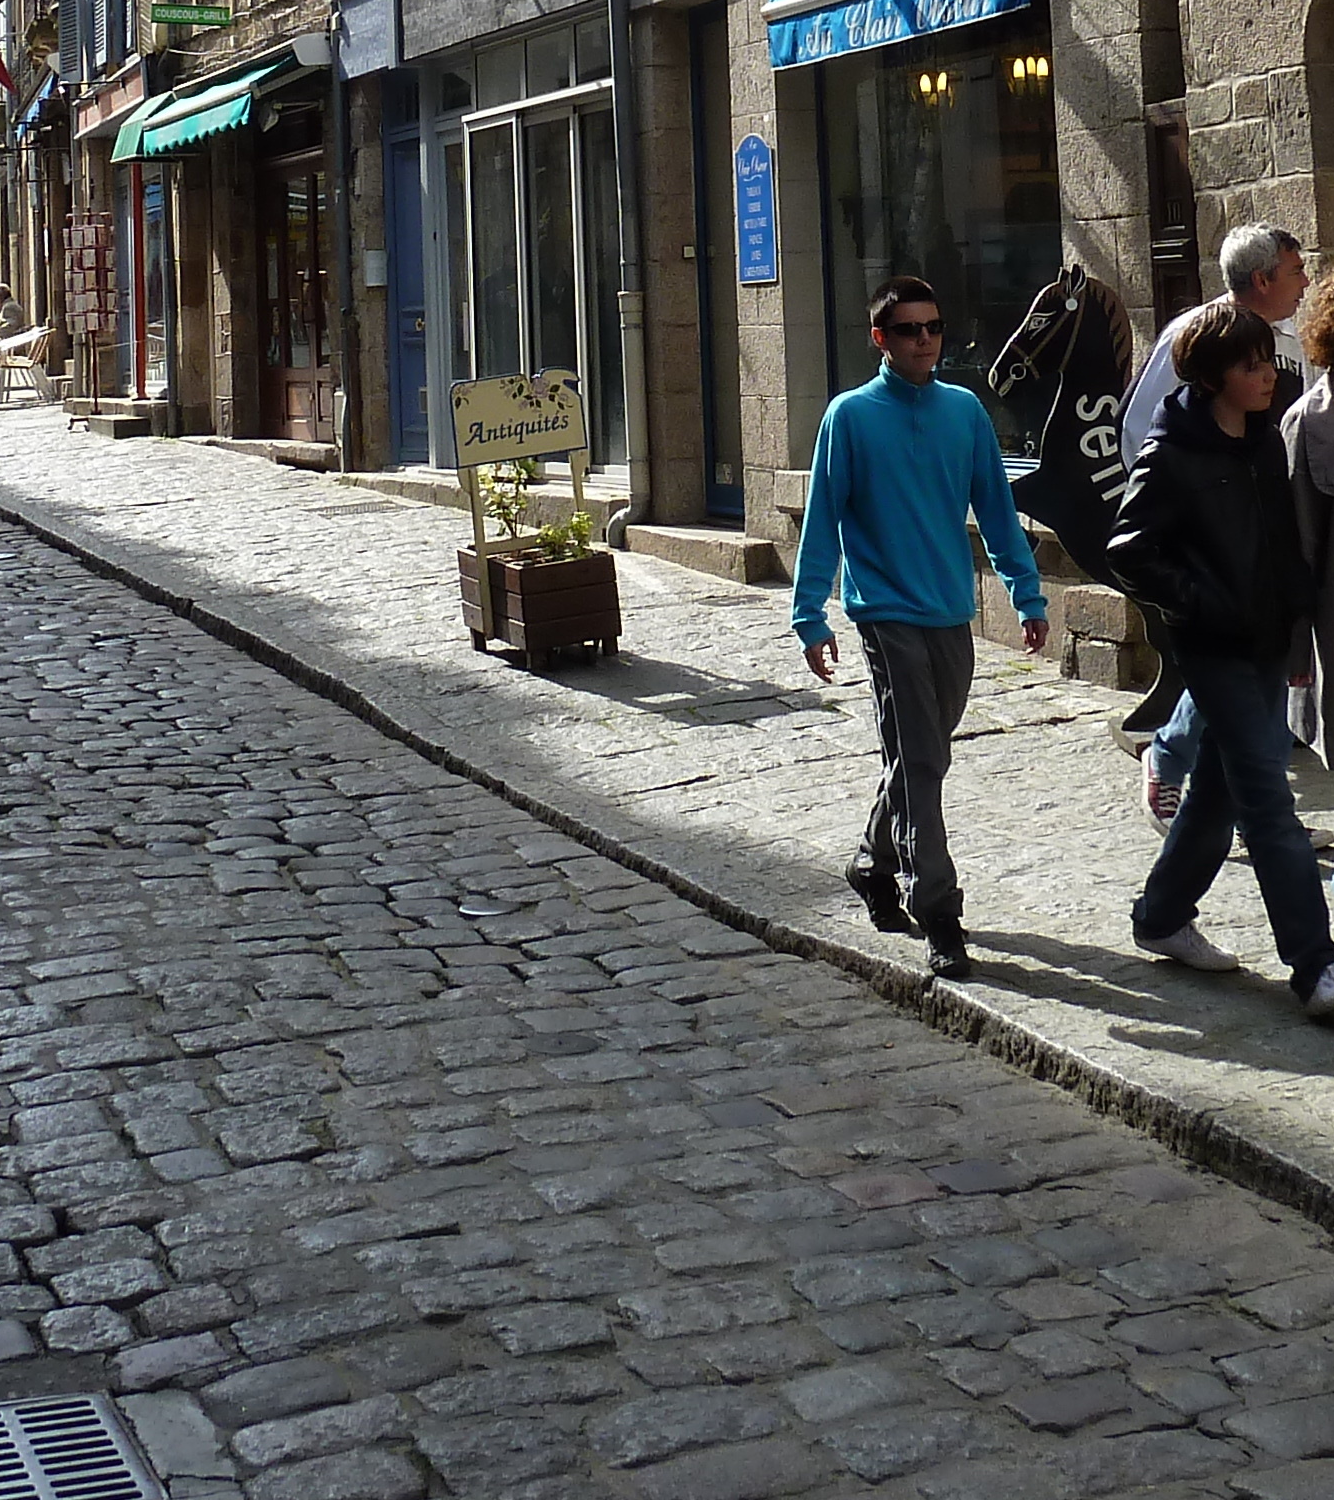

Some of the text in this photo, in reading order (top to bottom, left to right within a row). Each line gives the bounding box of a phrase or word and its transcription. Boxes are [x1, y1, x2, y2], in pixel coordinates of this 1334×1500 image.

[154, 8, 227, 20] COUSCOUS-GRILL
[798, 19, 832, 58] Au
[464, 409, 569, 446] Antiquités
[1075, 393, 1128, 502] Sell
